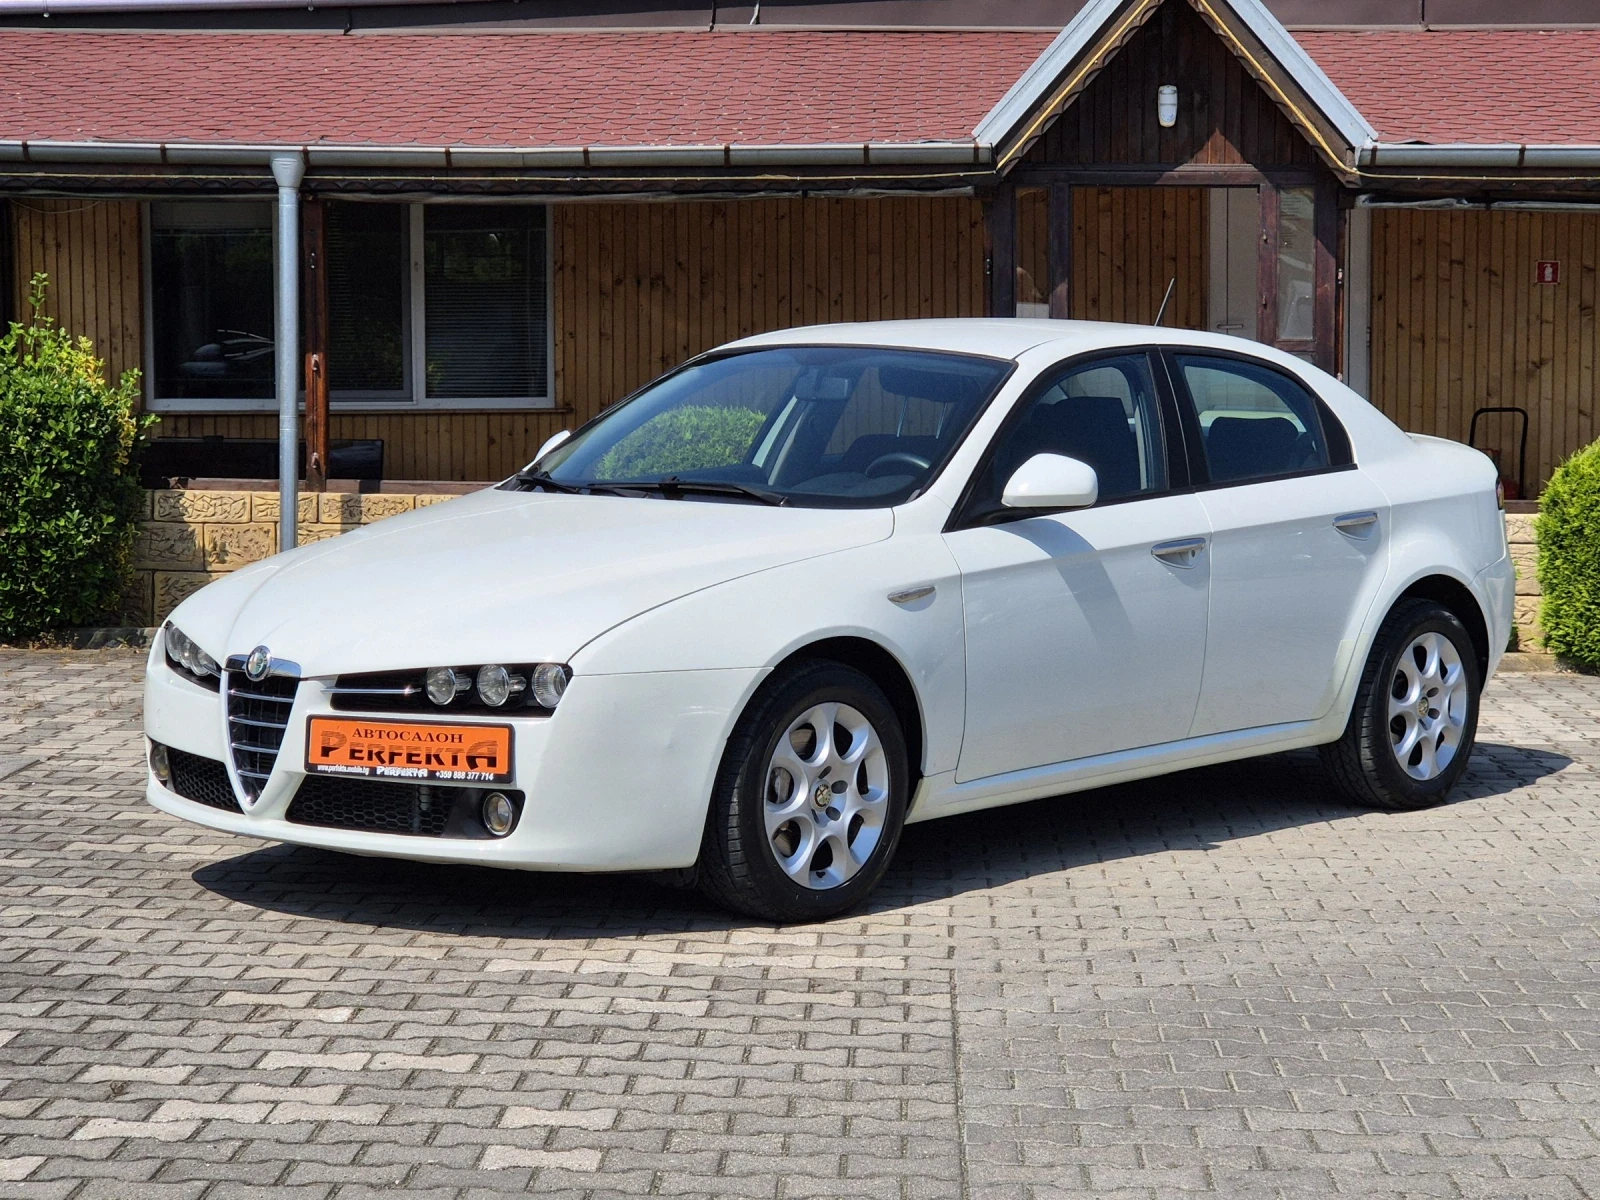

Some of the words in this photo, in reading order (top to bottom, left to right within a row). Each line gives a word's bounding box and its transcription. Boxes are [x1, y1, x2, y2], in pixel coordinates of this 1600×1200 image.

[352, 728, 464, 743] АВТОСАЛОН
[320, 730, 498, 770] PERFEKTA
[435, 770, 452, 779] +359
[453, 771, 465, 779] 888
[466, 772, 479, 780] 377
[480, 772, 494, 781] 714
